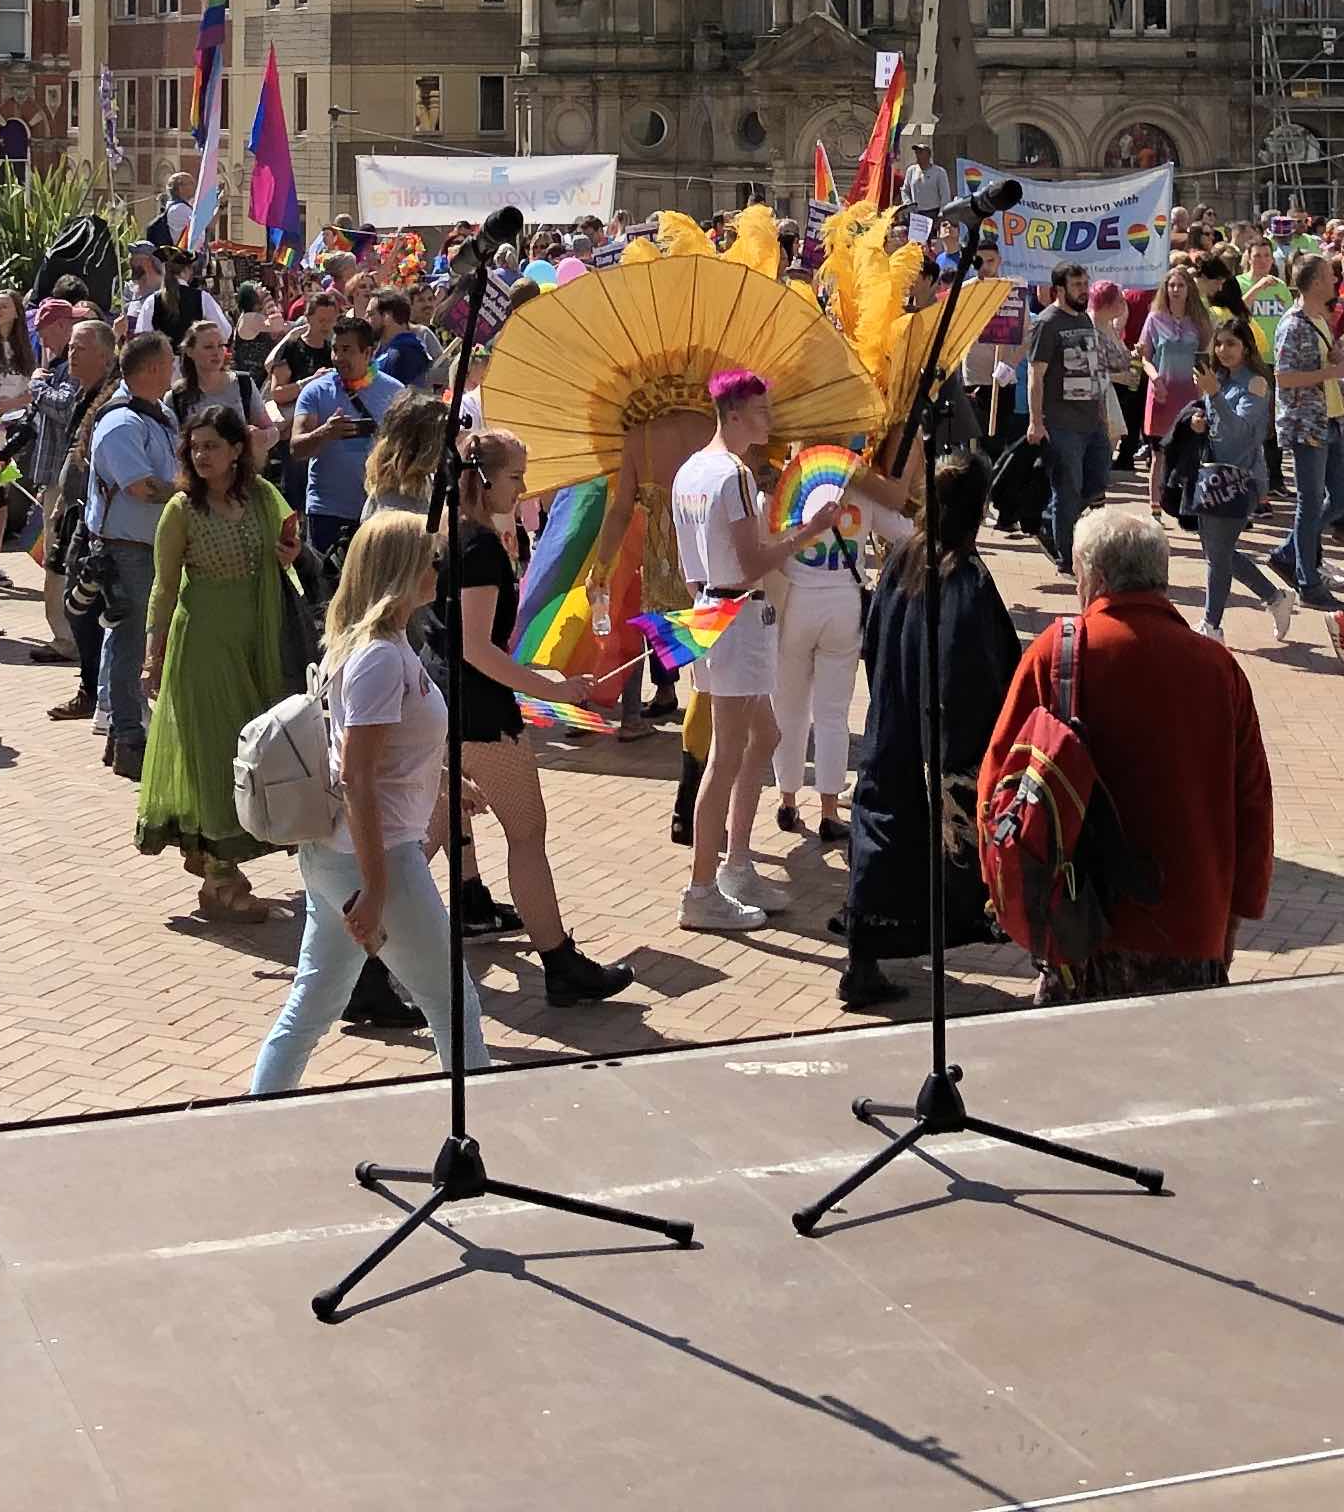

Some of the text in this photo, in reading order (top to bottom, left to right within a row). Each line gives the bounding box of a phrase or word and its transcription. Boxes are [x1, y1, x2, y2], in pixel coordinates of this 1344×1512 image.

[1070, 202, 1111, 214] caring
[1113, 194, 1140, 208] with
[1003, 210, 1121, 252] PRIDE
